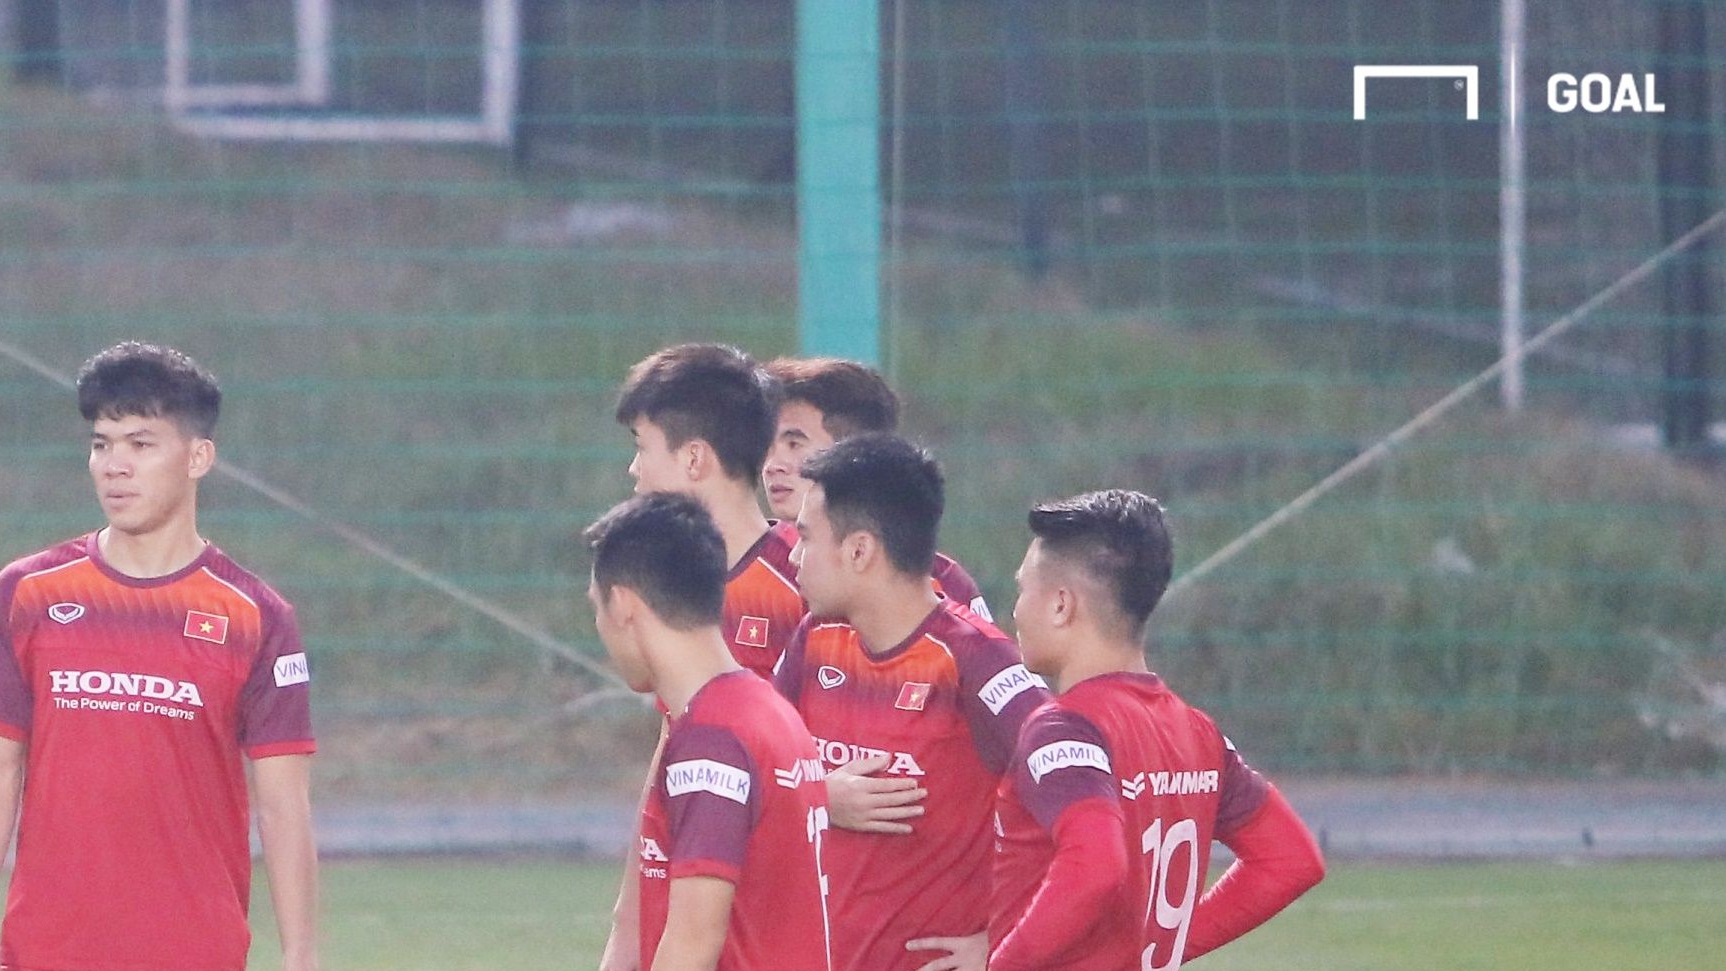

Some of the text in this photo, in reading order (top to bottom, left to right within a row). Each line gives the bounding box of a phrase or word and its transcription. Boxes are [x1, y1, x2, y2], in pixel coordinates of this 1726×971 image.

[49, 671, 204, 708] HONDA
[54, 697, 195, 721] The Power of Dreams
[666, 768, 748, 796] VINAMILK
